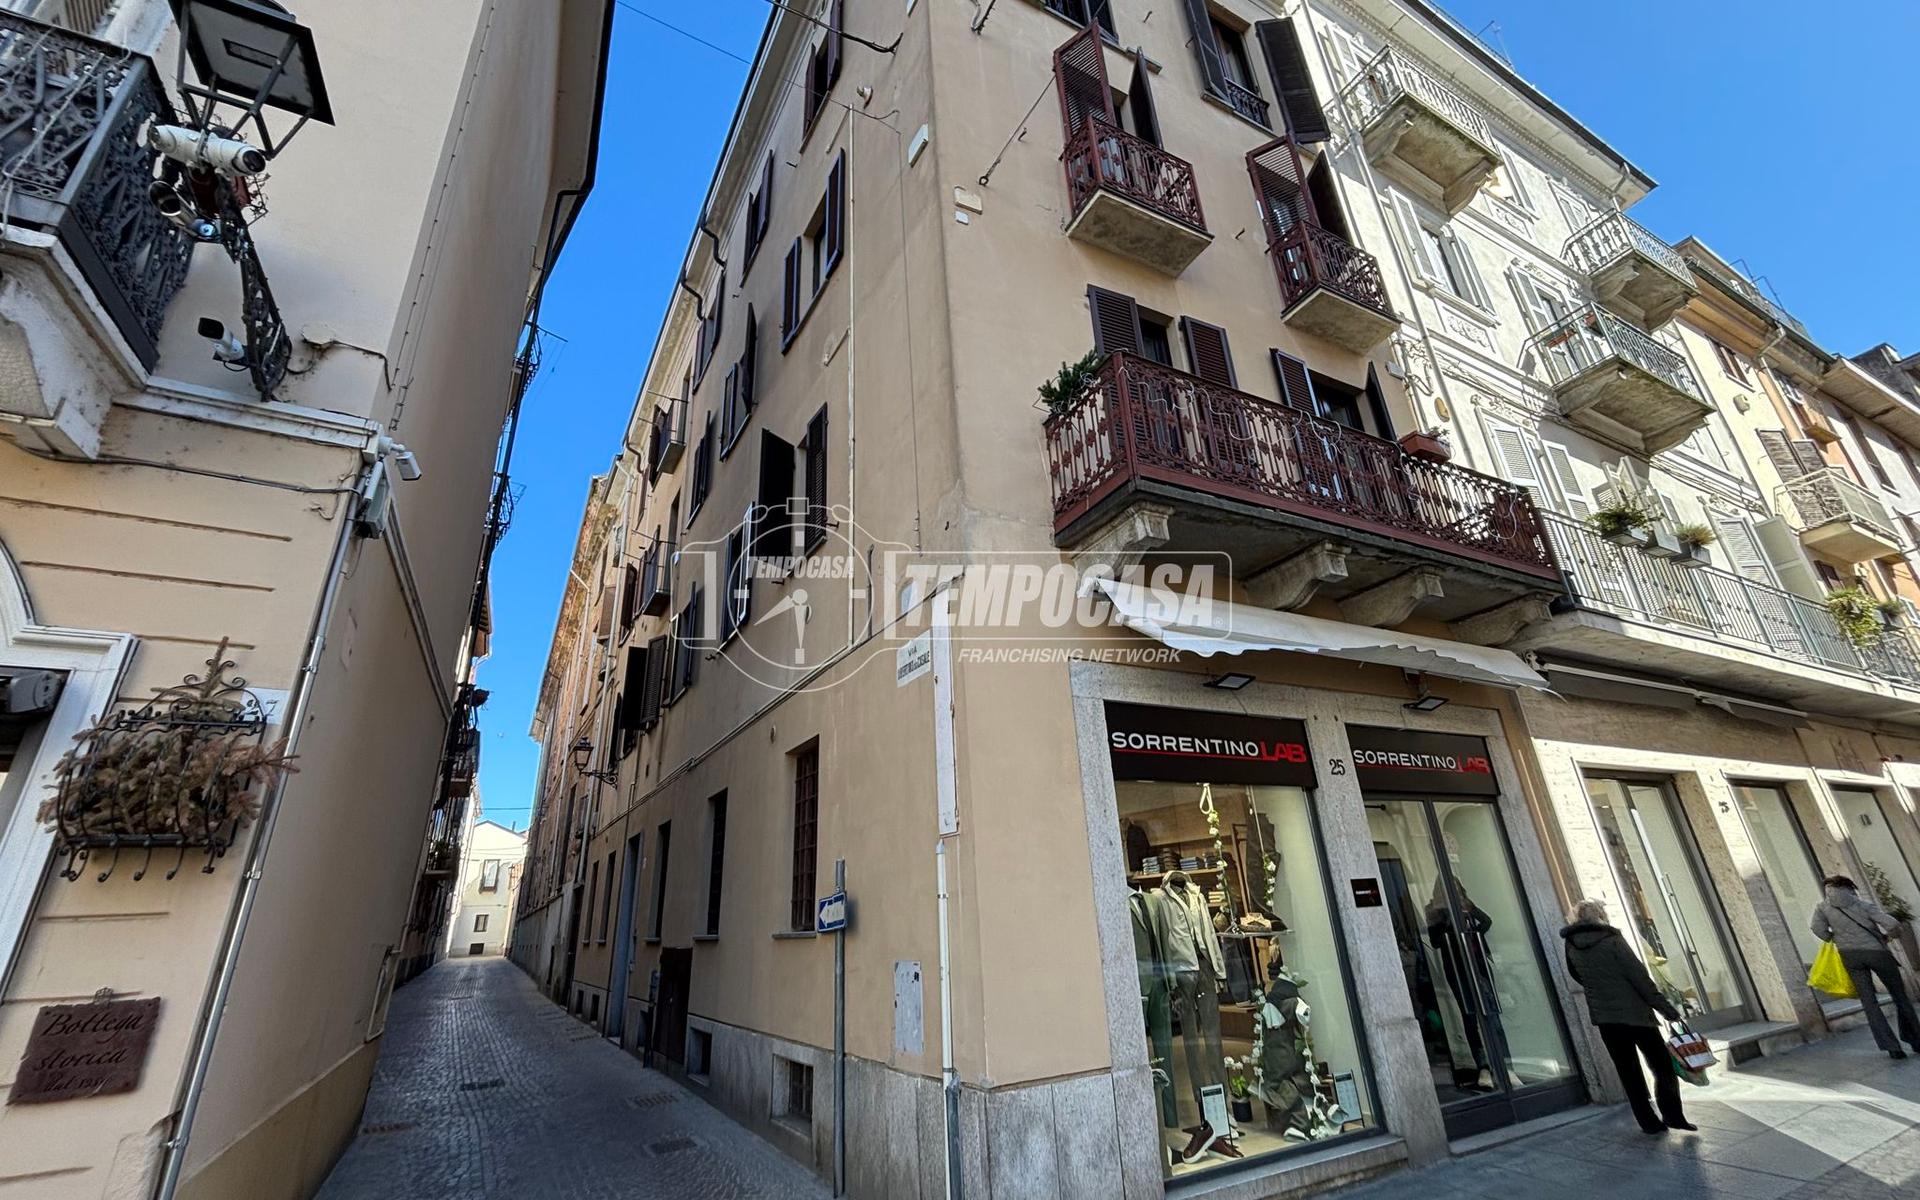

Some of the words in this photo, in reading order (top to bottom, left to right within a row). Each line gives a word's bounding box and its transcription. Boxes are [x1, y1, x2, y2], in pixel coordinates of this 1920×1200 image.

[907, 645, 917, 657] VIA
[1329, 758, 1346, 776] 25
[42, 1011, 143, 1044] Bottega
[34, 1048, 127, 1072] storica
